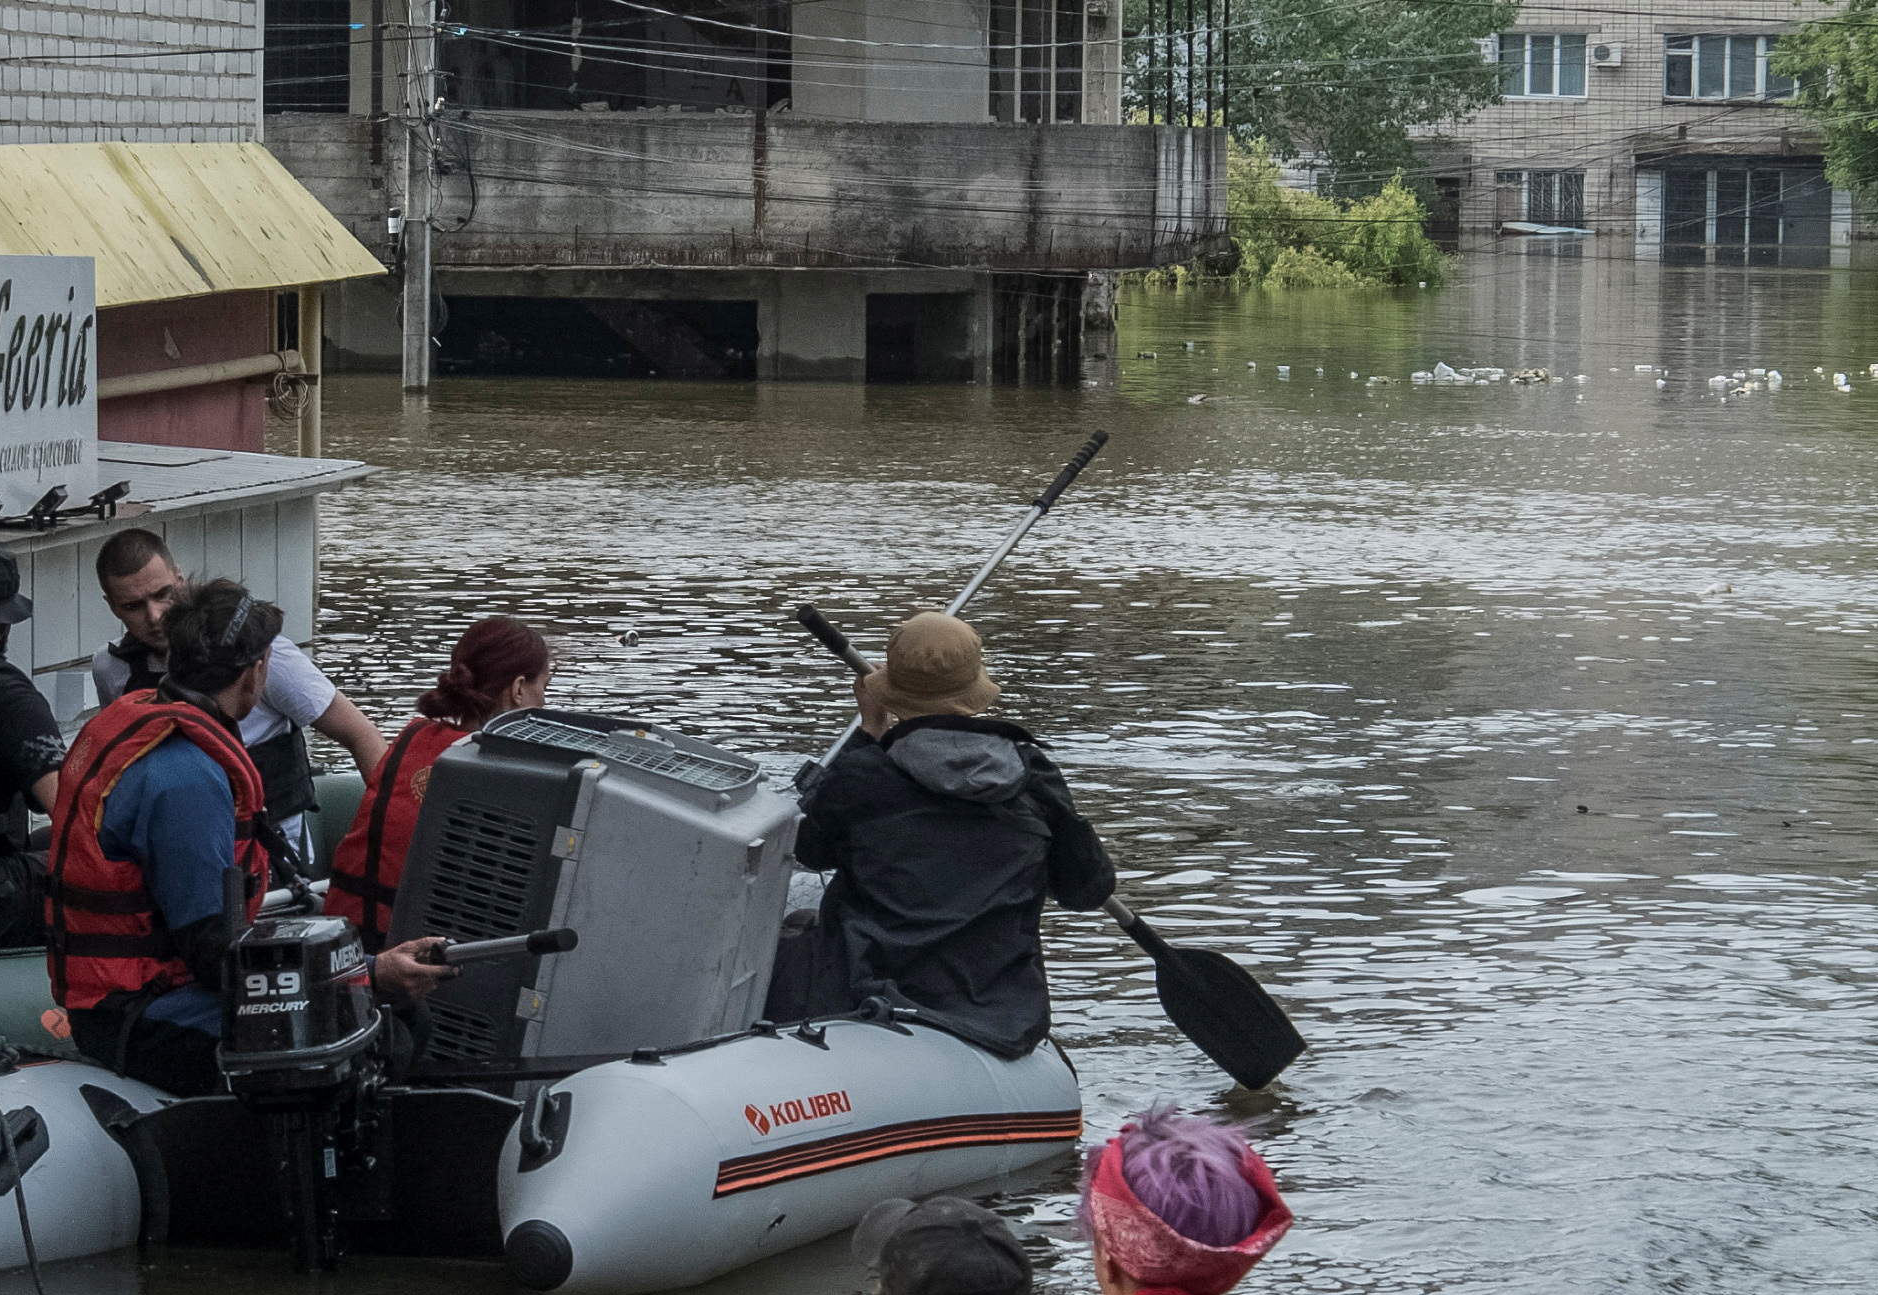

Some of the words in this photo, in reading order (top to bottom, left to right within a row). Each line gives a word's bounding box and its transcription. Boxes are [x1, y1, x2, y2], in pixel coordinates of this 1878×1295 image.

[246, 972, 301, 997] 9.9
[237, 1000, 311, 1016] MERCURY
[769, 1090, 852, 1127] KOLIBRI
